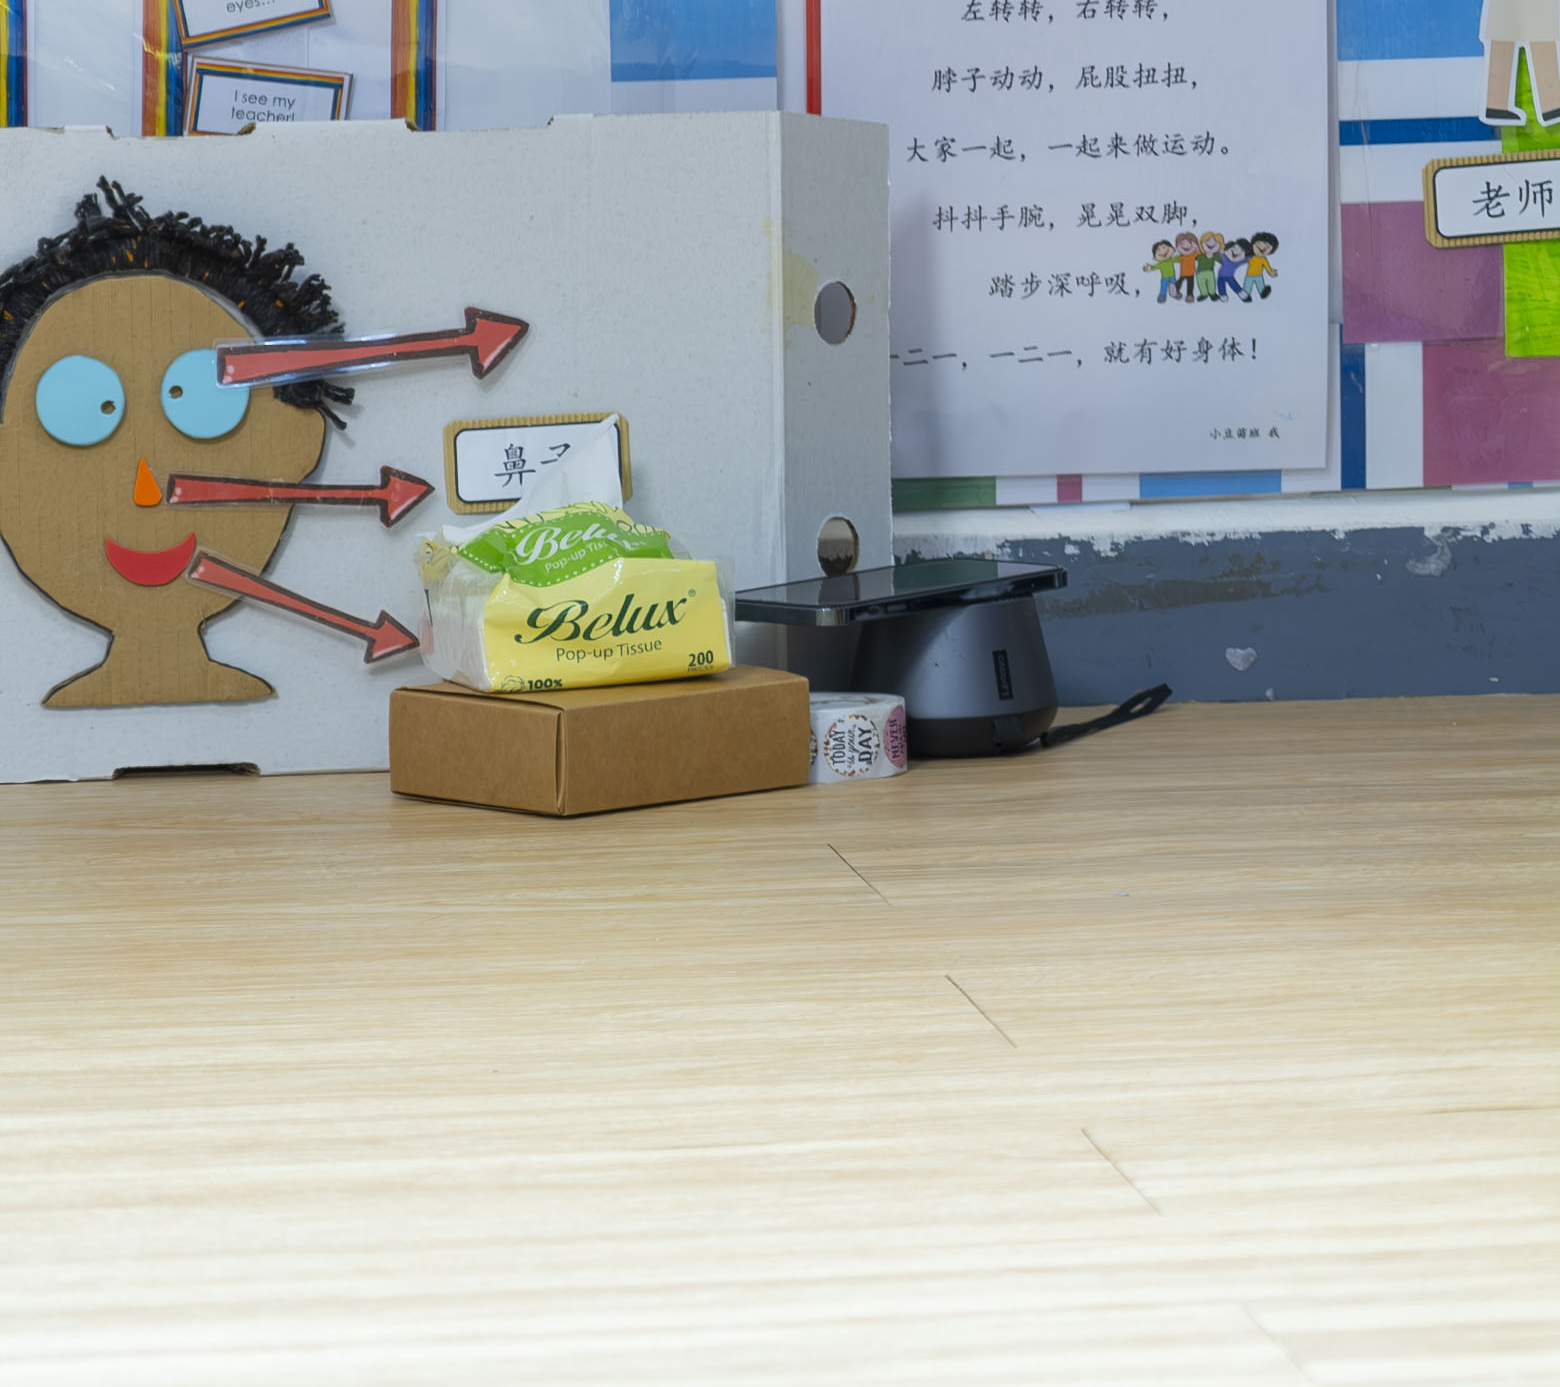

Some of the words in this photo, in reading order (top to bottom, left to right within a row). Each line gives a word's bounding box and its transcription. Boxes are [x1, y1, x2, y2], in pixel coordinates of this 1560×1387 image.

[242, 92, 268, 105] see
[272, 96, 296, 108] my
[1471, 177, 1554, 219] 老师
[544, 546, 586, 572] Pop-up
[556, 643, 614, 663] Pop-up
[616, 638, 663, 656] Tissue
[688, 650, 714, 667] 200
[527, 678, 563, 691] 100%
[831, 729, 846, 766] TODAY
[857, 727, 872, 765] DAY
